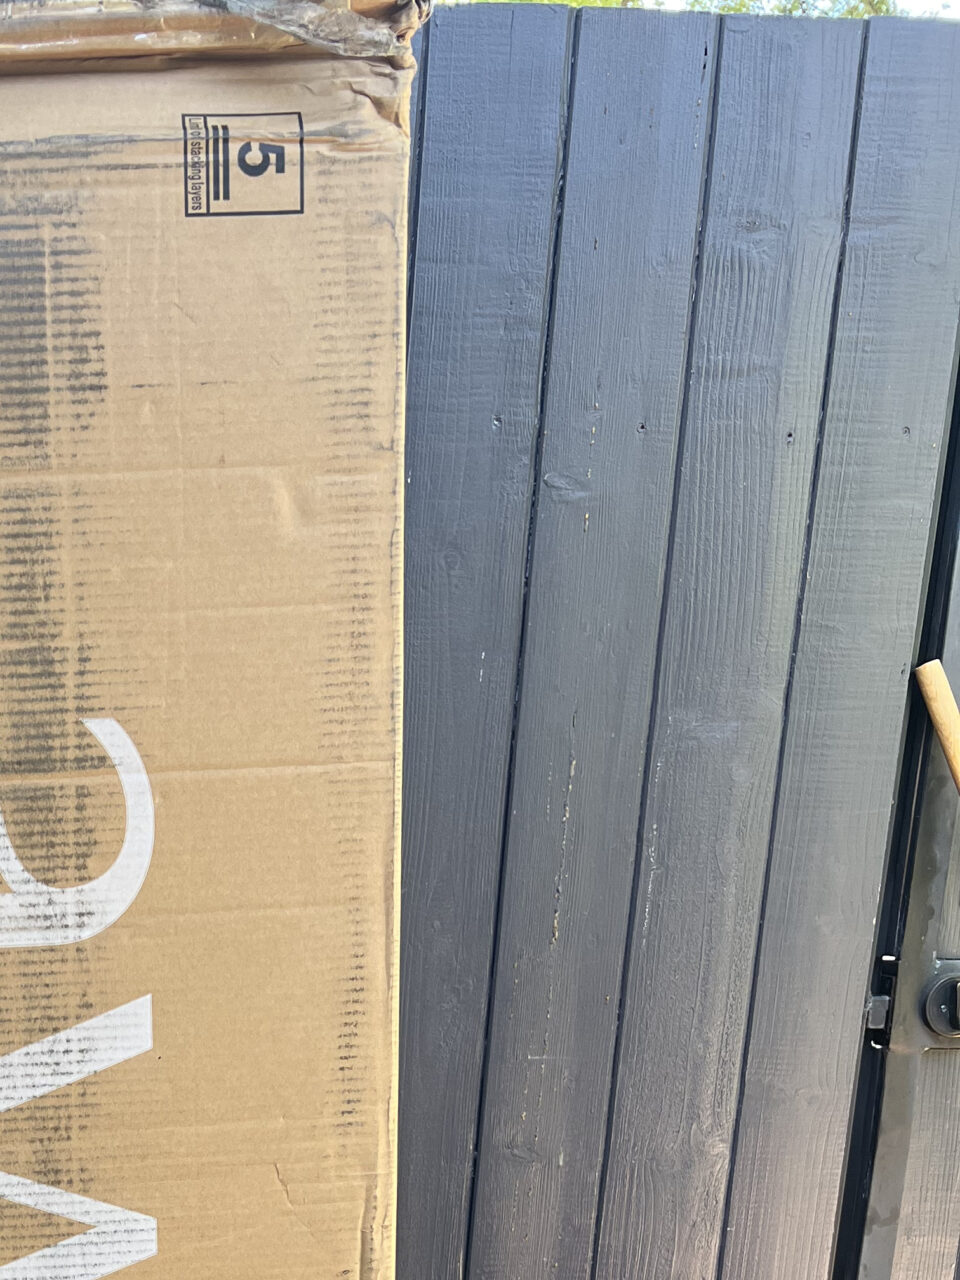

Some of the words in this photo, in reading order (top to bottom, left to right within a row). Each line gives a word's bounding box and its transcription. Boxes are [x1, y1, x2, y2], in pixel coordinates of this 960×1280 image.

[188, 141, 205, 180] stacking
[238, 141, 285, 177] 5
[188, 182, 205, 210] layers
